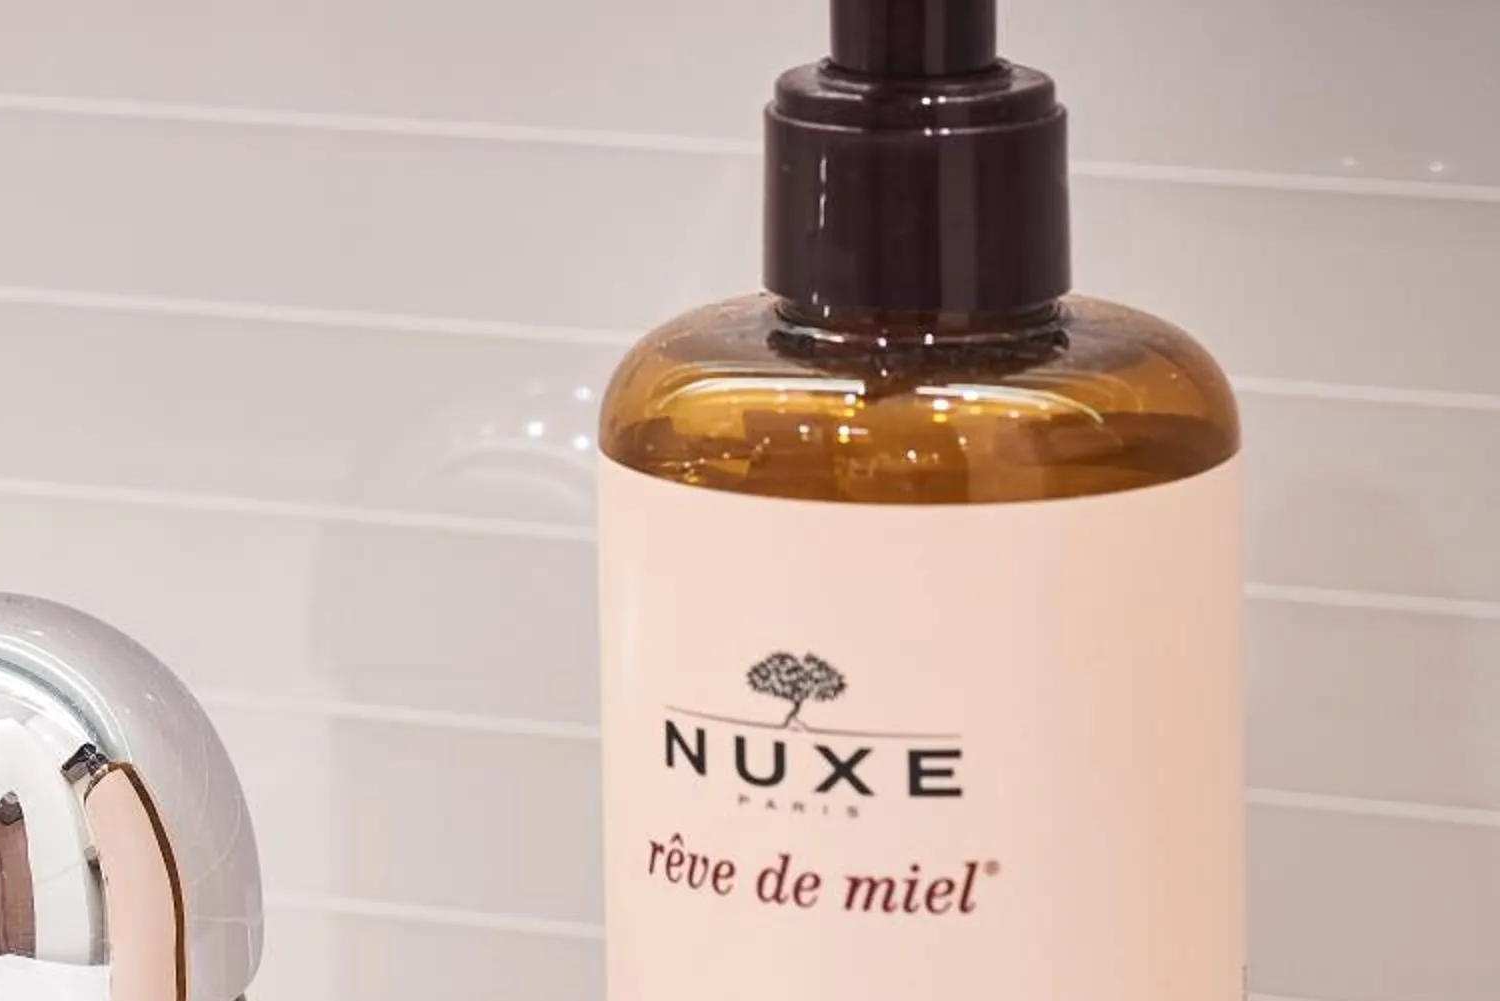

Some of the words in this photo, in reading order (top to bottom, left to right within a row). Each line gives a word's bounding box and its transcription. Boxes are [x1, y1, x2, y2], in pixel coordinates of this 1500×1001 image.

[664, 719, 964, 798] NUXE
[649, 832, 737, 896] rêve
[756, 853, 822, 908] de
